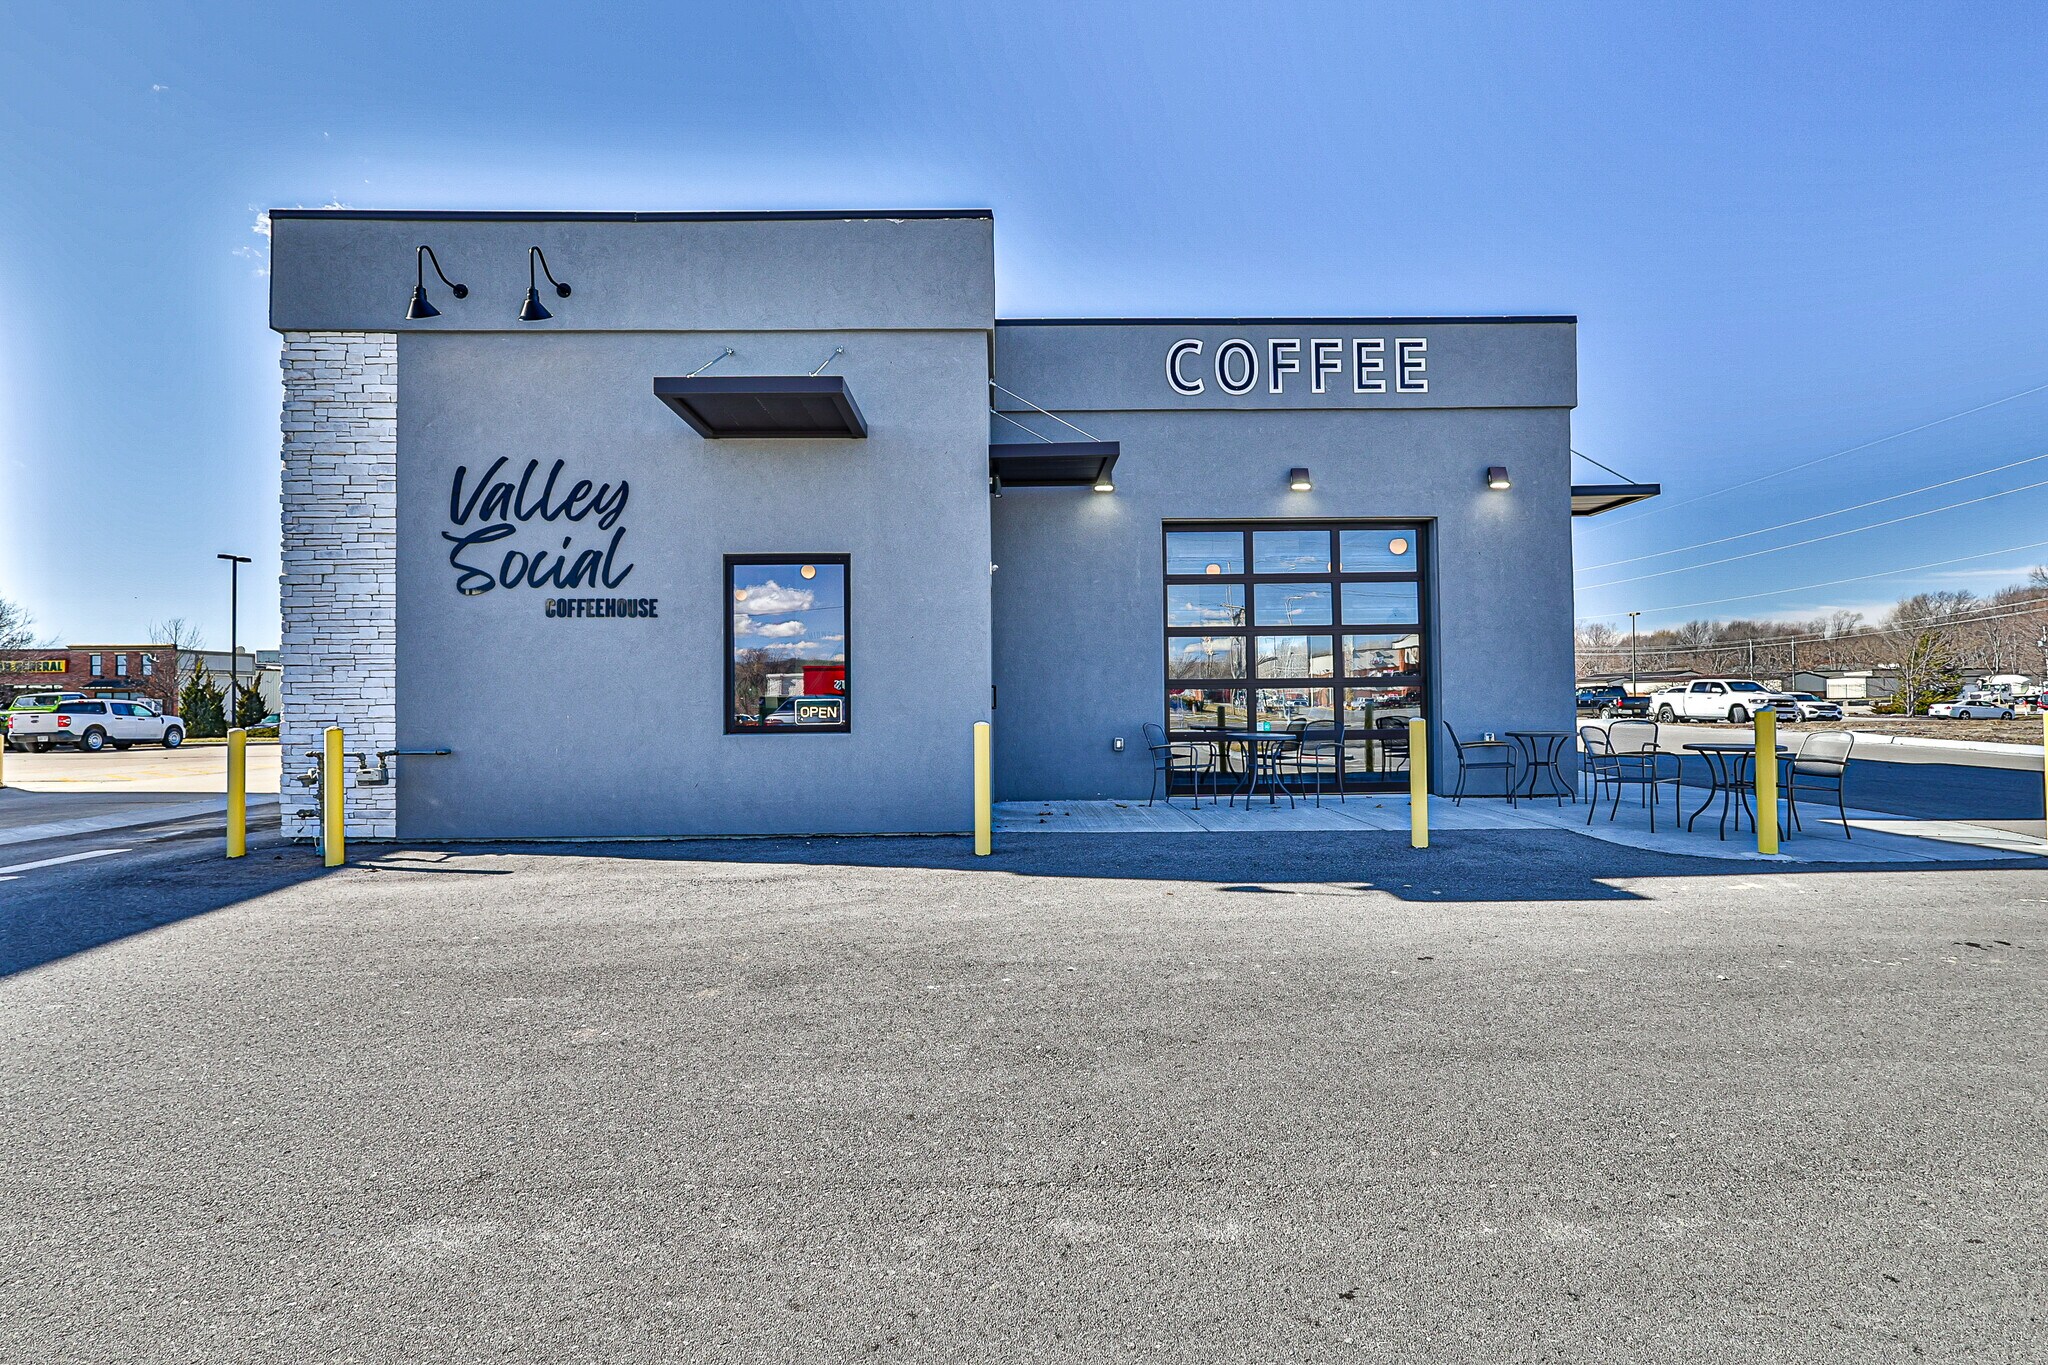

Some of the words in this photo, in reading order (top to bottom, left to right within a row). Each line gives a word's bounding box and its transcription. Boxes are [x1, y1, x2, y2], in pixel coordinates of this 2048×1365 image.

[1165, 338, 1429, 396] COFFEE
[450, 456, 629, 531] Valley
[441, 523, 634, 596] Social
[545, 598, 659, 618] COFFEEHOUSE
[800, 706, 837, 718] OPEN
